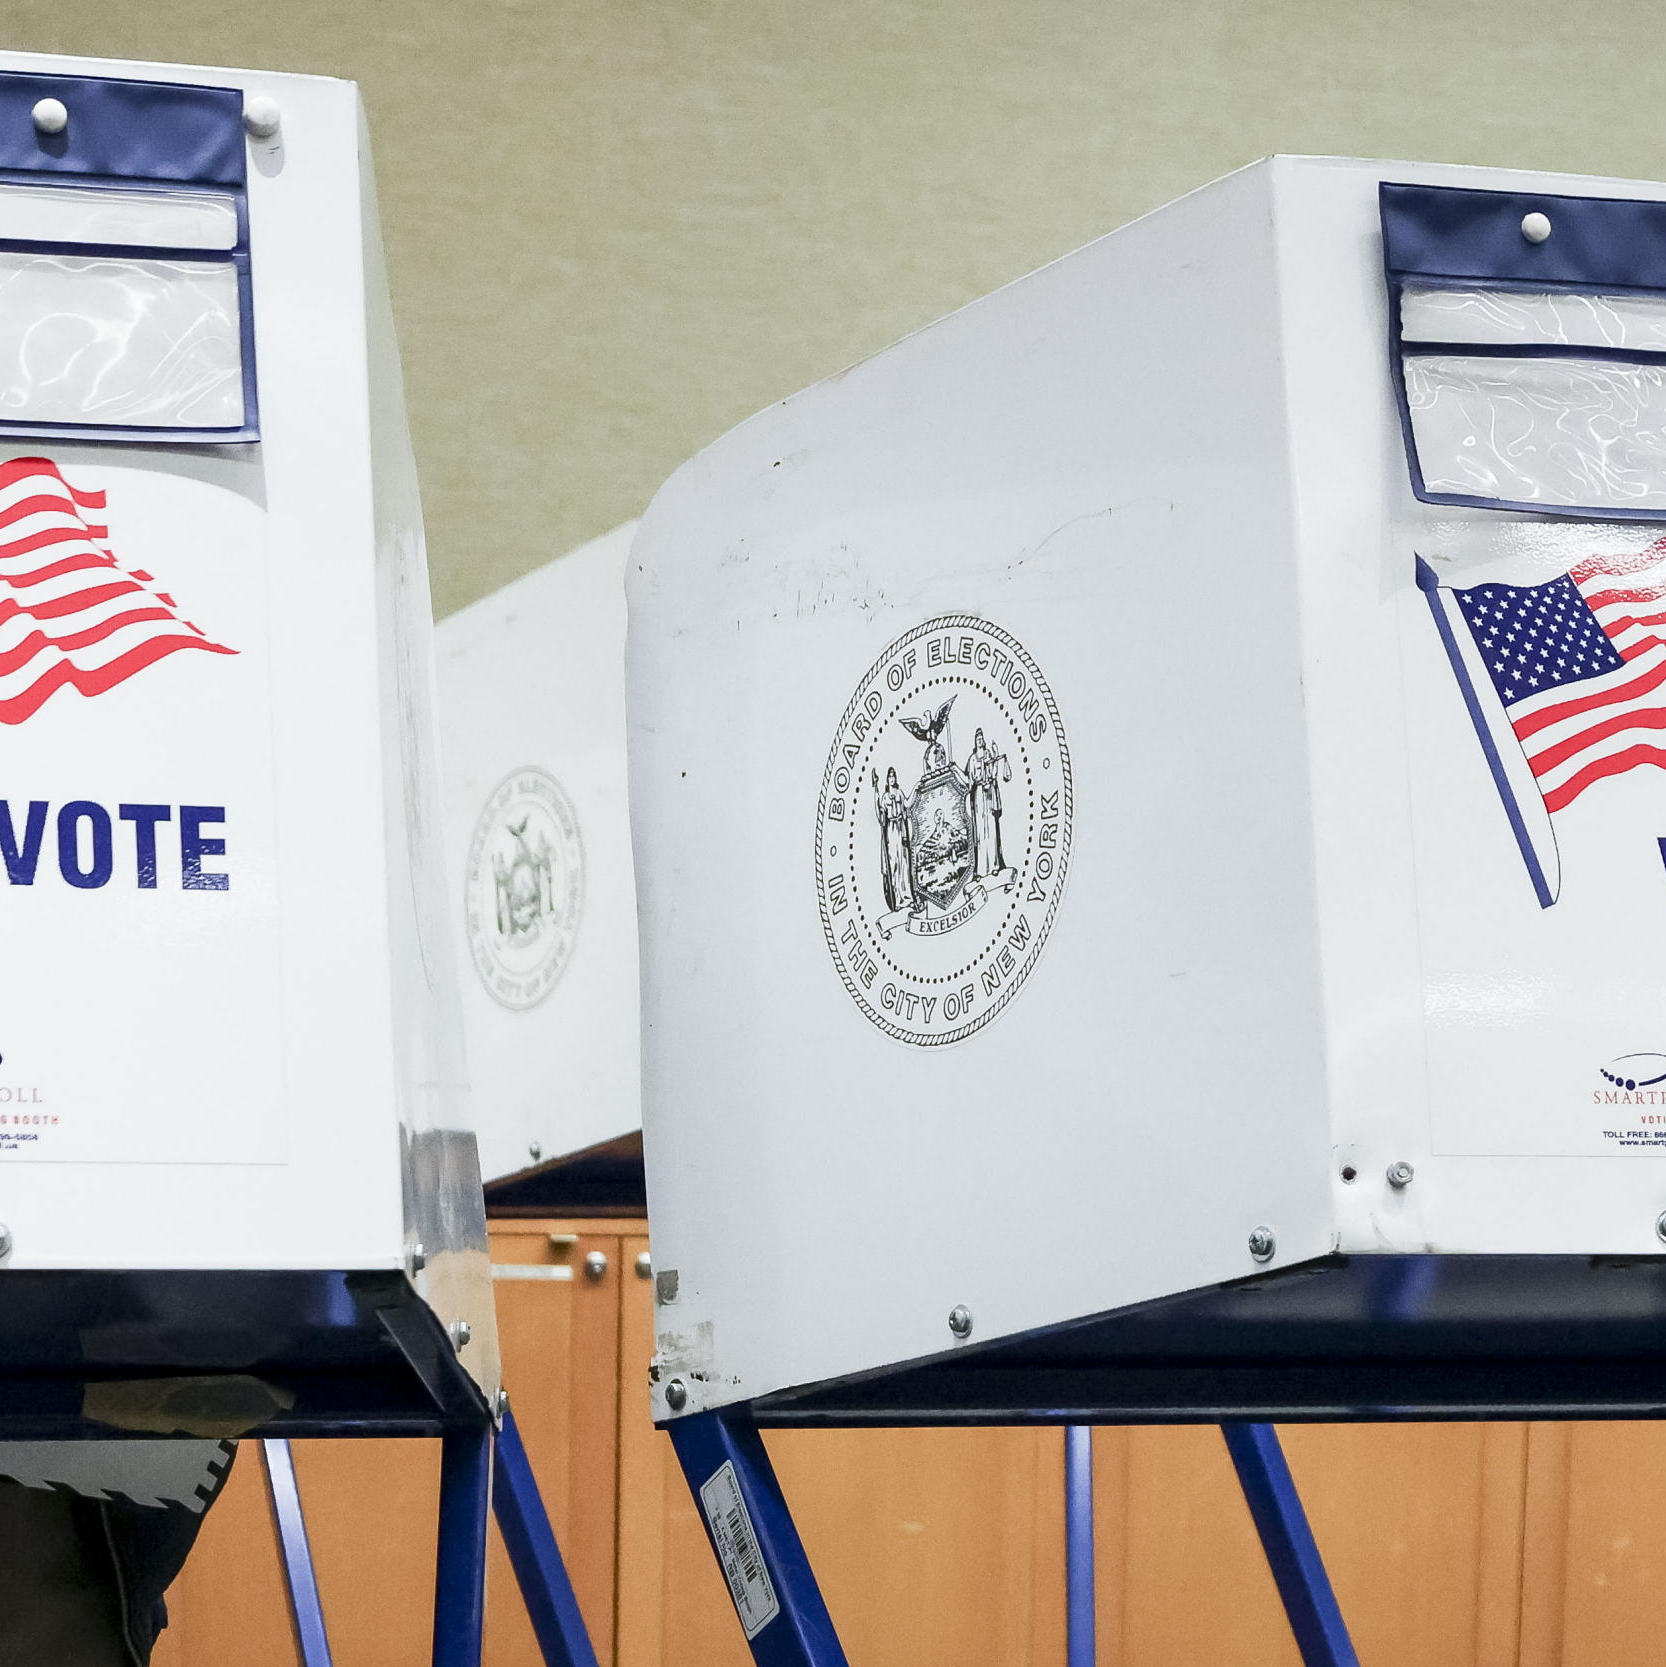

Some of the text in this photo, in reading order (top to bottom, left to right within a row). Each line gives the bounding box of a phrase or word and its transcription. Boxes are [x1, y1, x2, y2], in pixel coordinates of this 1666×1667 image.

[829, 637, 1047, 821] BOARD OF ELECTIONS
[827, 789, 1061, 1024] IN THE CITY OF NEW YORK
[919, 902, 976, 933] EXCELSIOR
[13, 1115, 60, 1125] BOOTH
[1603, 1131, 1624, 1139] TOLL
[1627, 1131, 1652, 1139] FREE:
